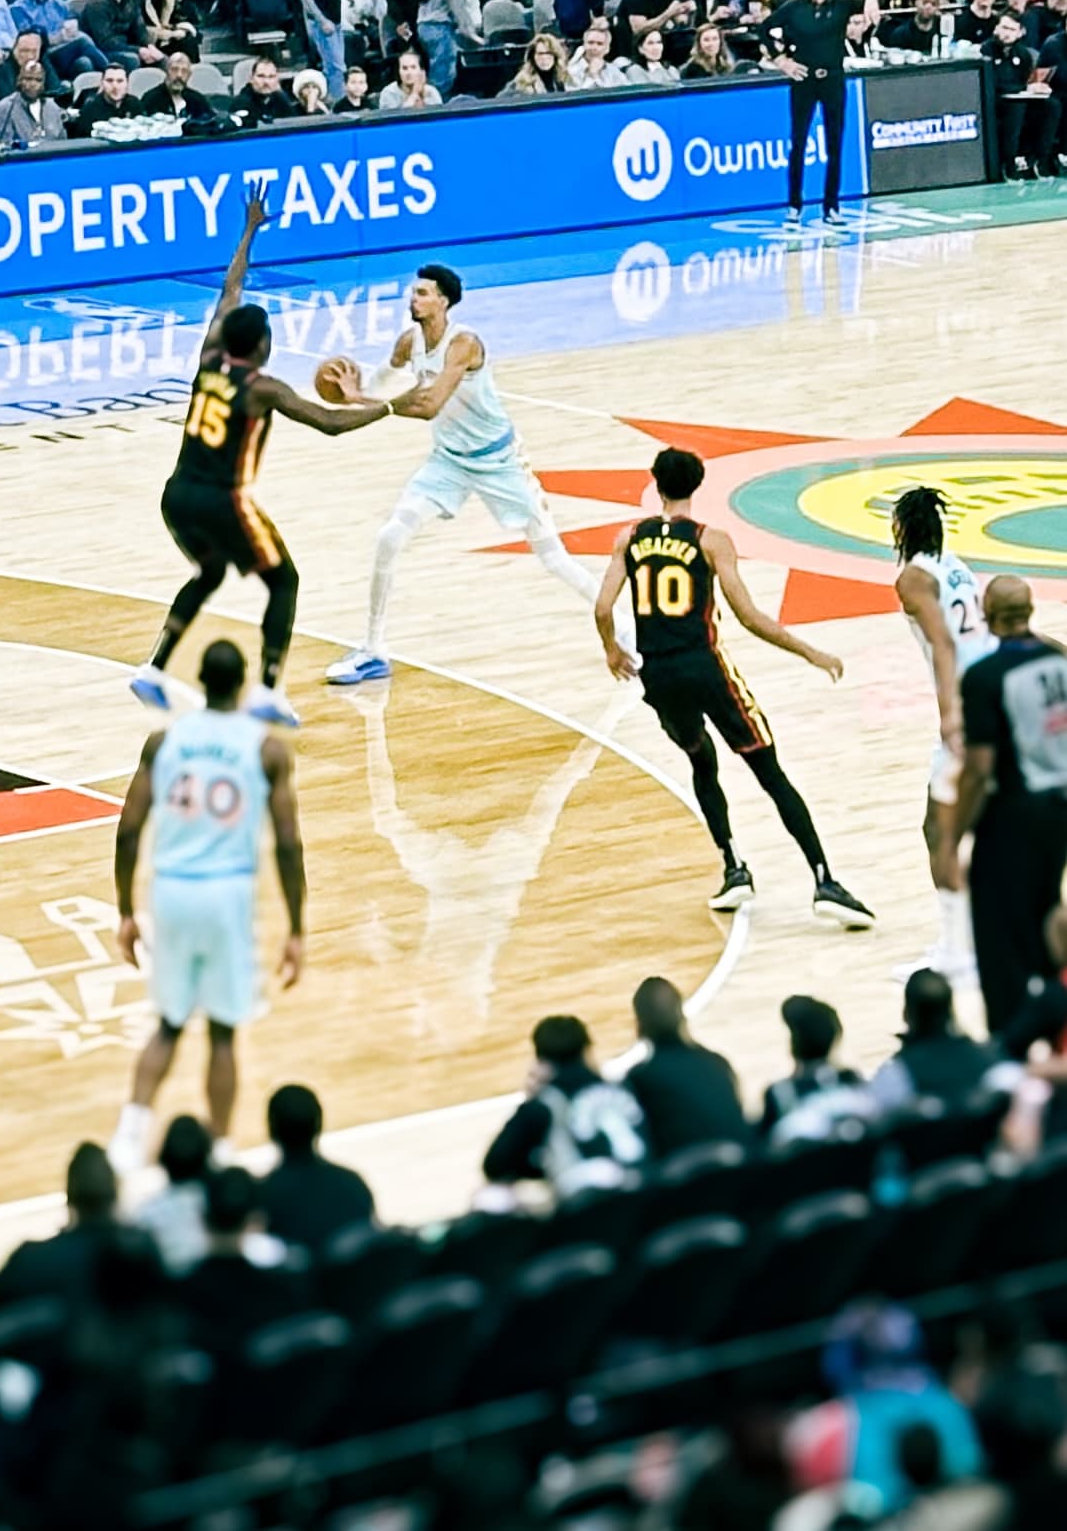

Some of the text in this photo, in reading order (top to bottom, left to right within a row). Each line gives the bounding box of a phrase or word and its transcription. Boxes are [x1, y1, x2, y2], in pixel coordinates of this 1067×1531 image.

[683, 124, 829, 177] Ownwel
[242, 151, 437, 232] TAXES
[187, 391, 232, 449] 15
[635, 564, 694, 617] 10
[166, 772, 242, 821] 40
